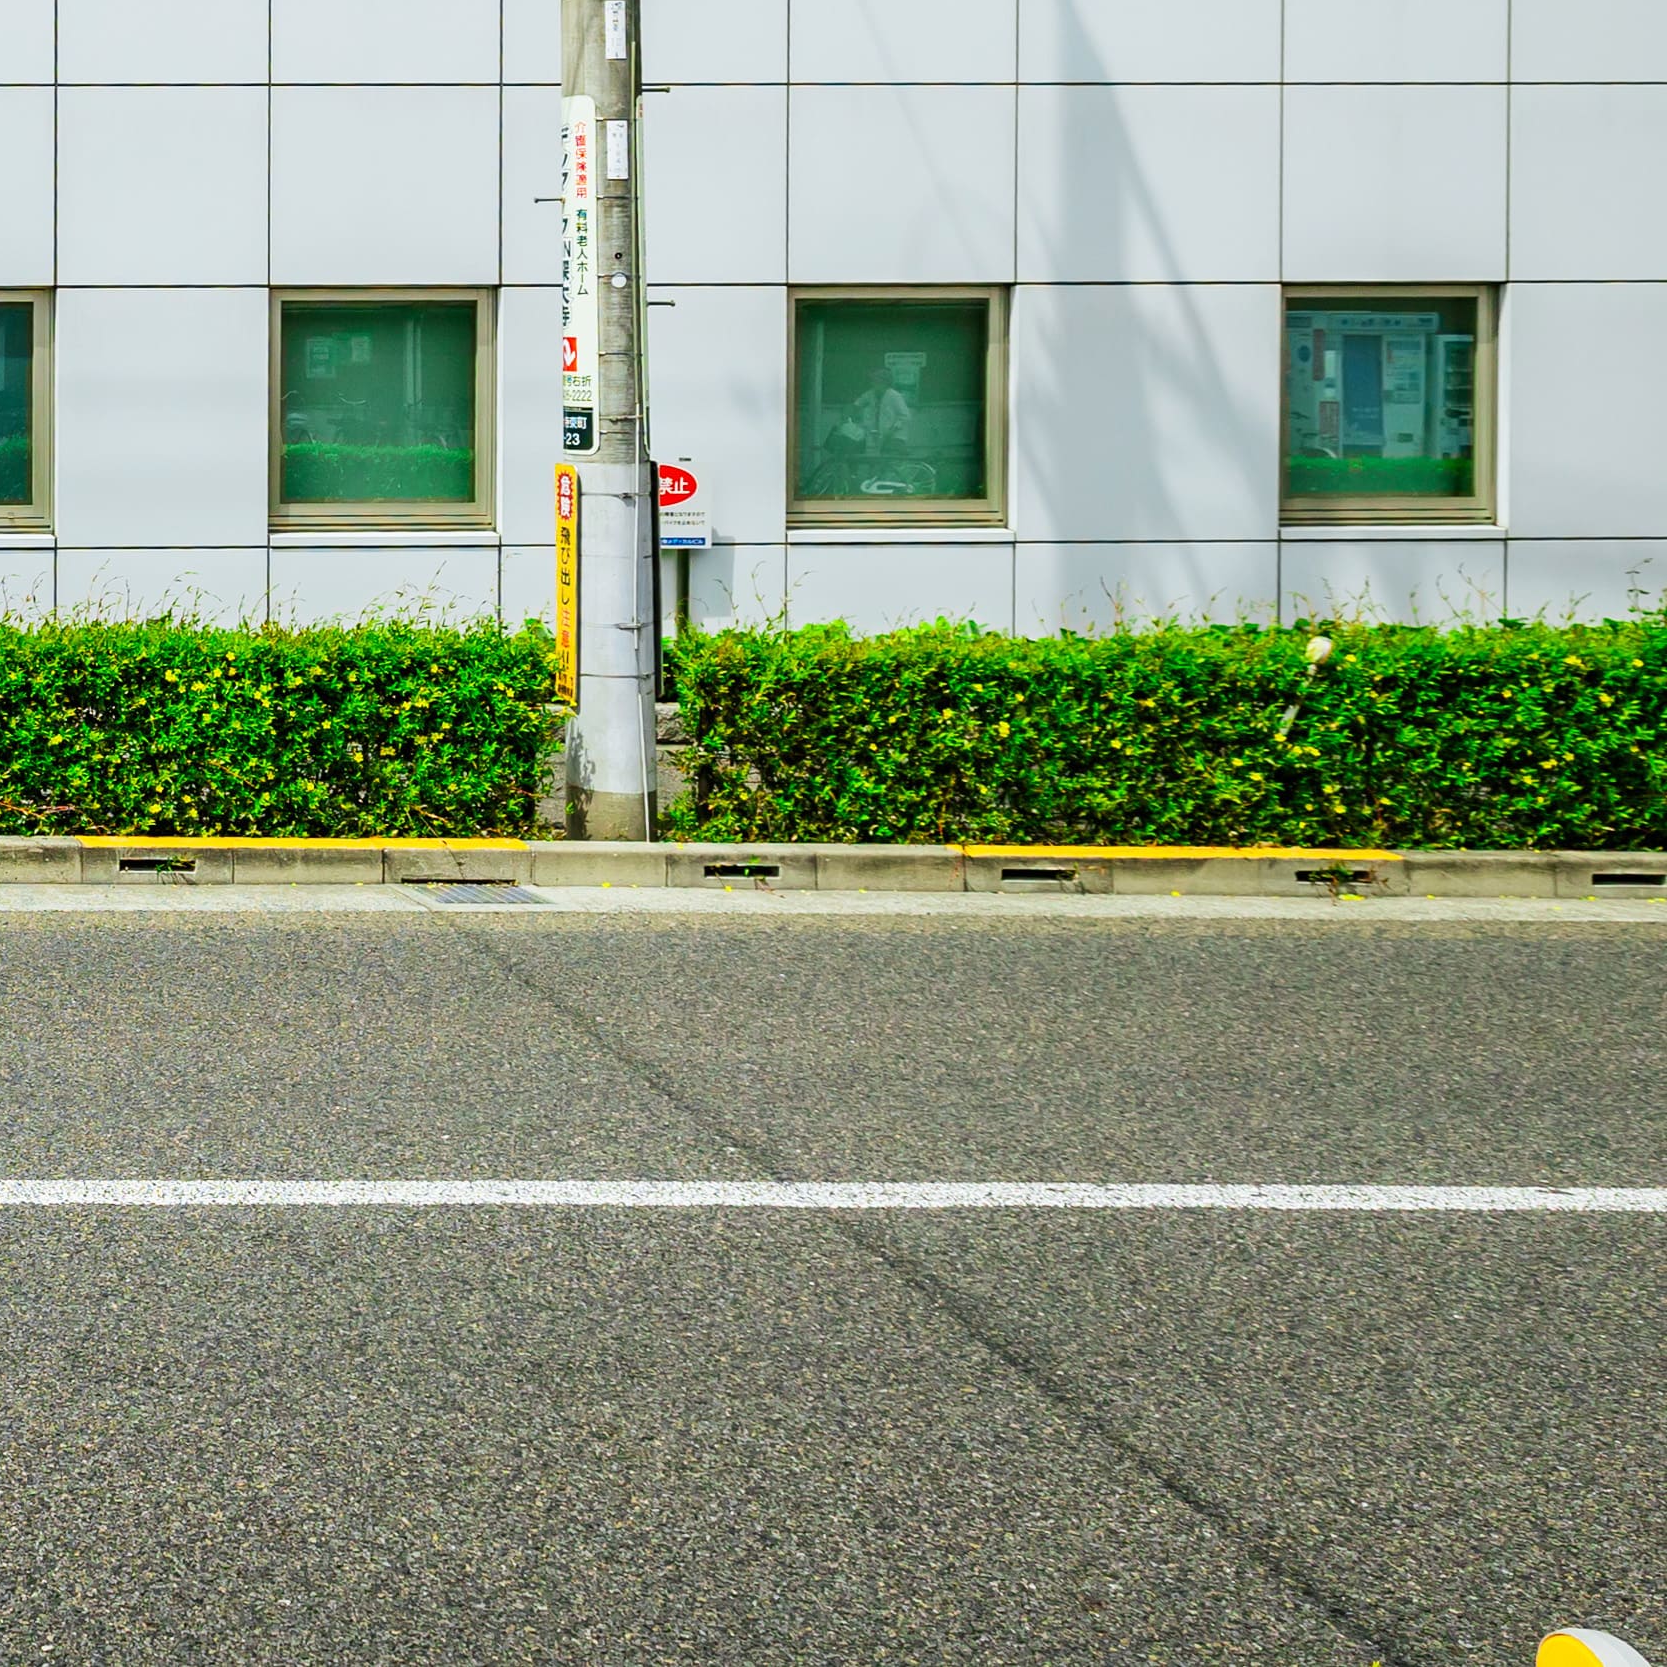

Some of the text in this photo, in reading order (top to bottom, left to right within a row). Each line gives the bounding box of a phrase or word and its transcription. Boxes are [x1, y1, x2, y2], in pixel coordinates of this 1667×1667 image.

[576, 208, 589, 296] 有料老人ホーム
